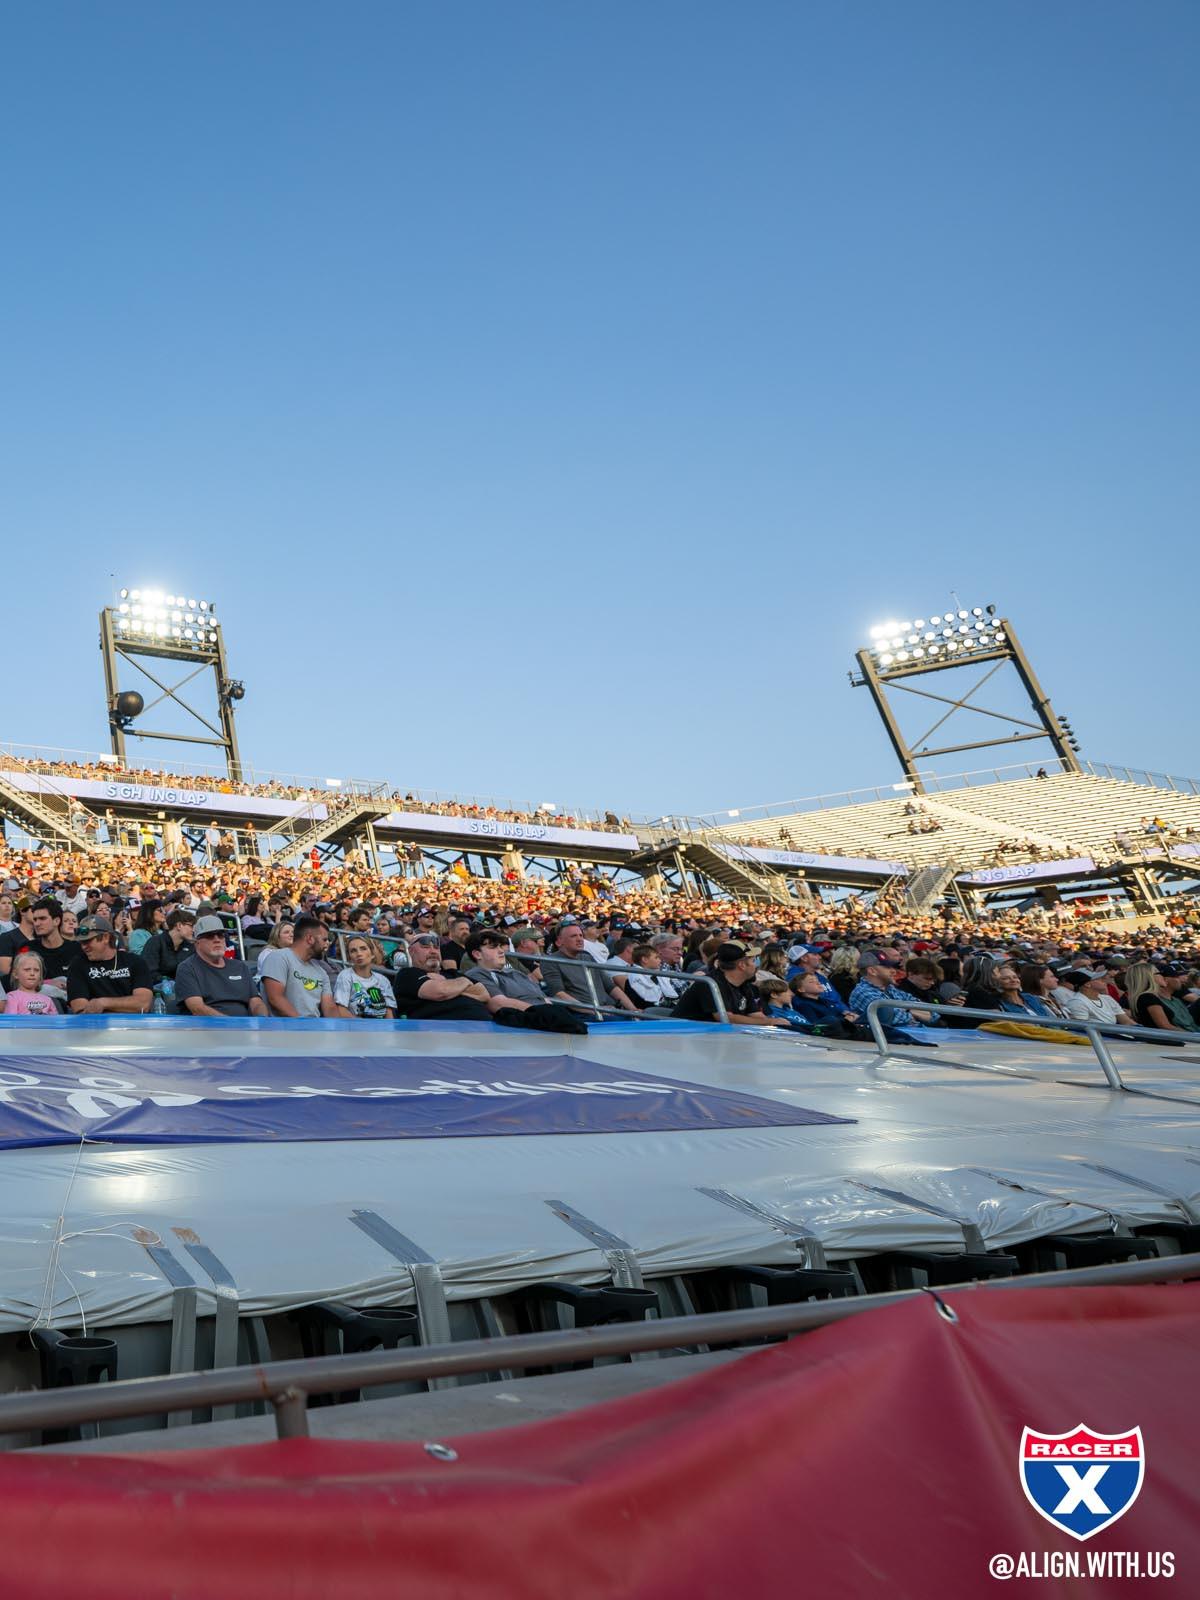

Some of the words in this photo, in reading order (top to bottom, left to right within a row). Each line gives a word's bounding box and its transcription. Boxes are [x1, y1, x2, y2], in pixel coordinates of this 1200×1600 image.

[180, 791, 207, 806] LAP
[525, 827, 545, 838] LAP
[1006, 865, 1036, 878] LAP
